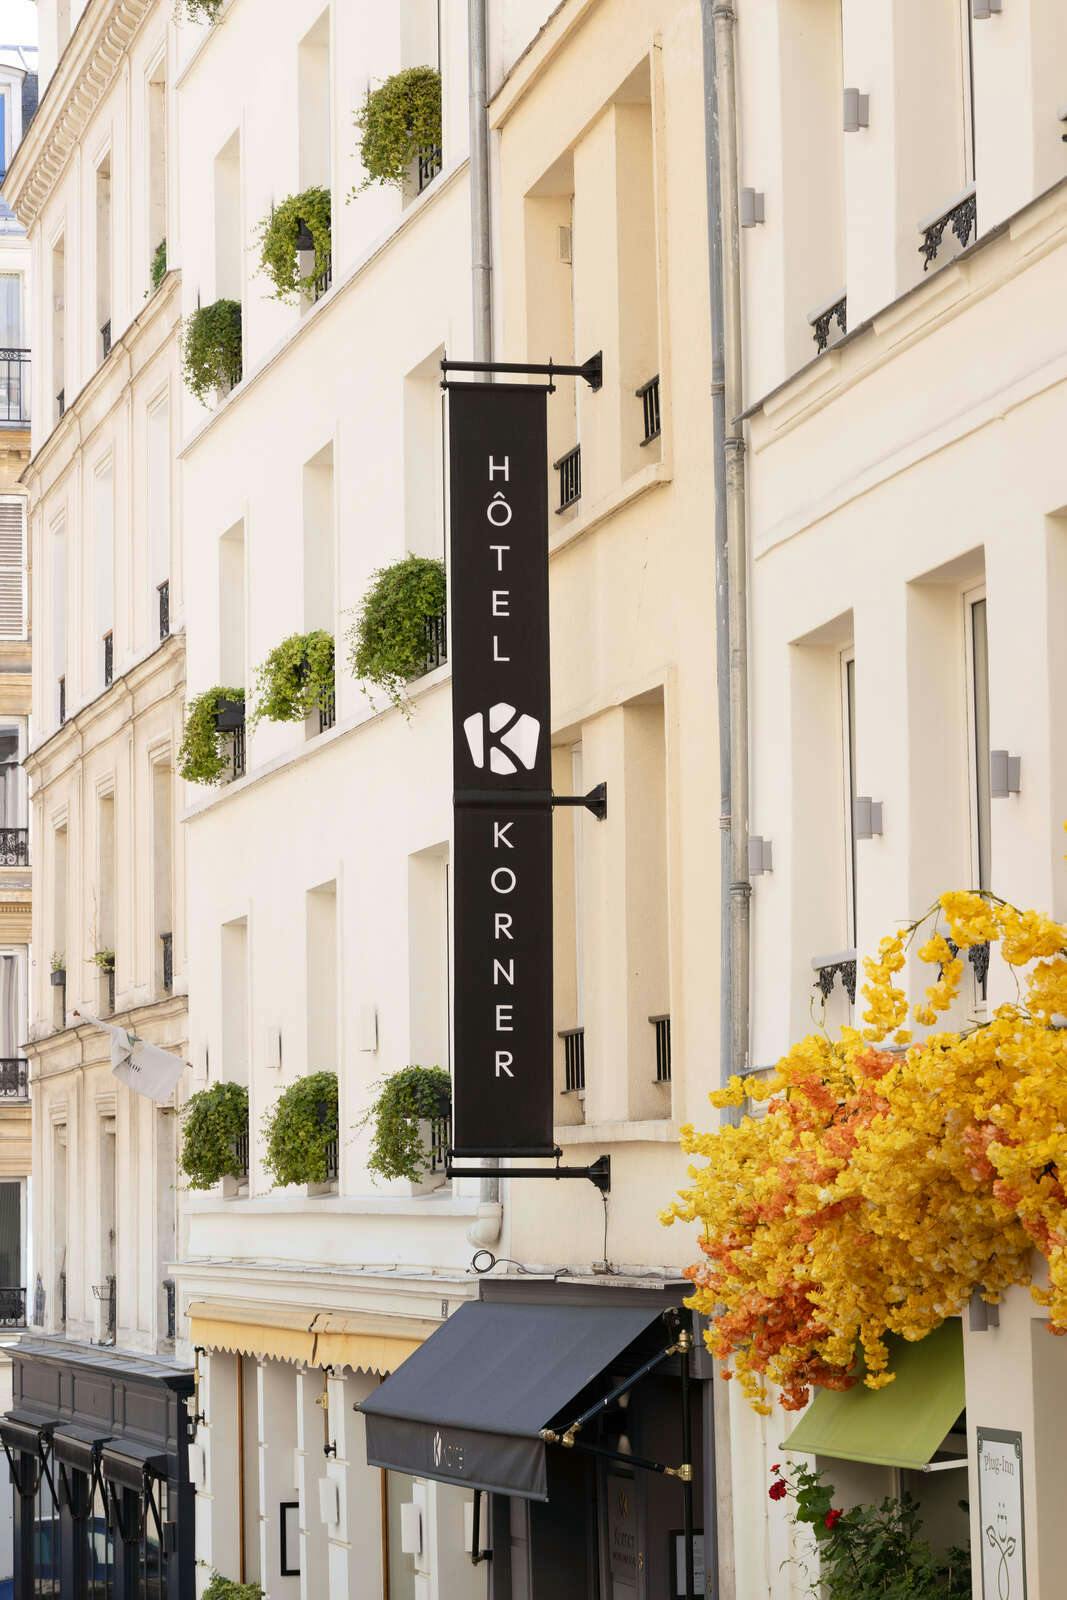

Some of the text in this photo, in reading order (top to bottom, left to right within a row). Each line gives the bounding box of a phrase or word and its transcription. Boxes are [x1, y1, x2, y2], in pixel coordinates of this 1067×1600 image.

[486, 455, 513, 662] HÔTEL
[490, 821, 517, 1078] KORNER
[983, 1452, 1015, 1476] Plug-Inn
